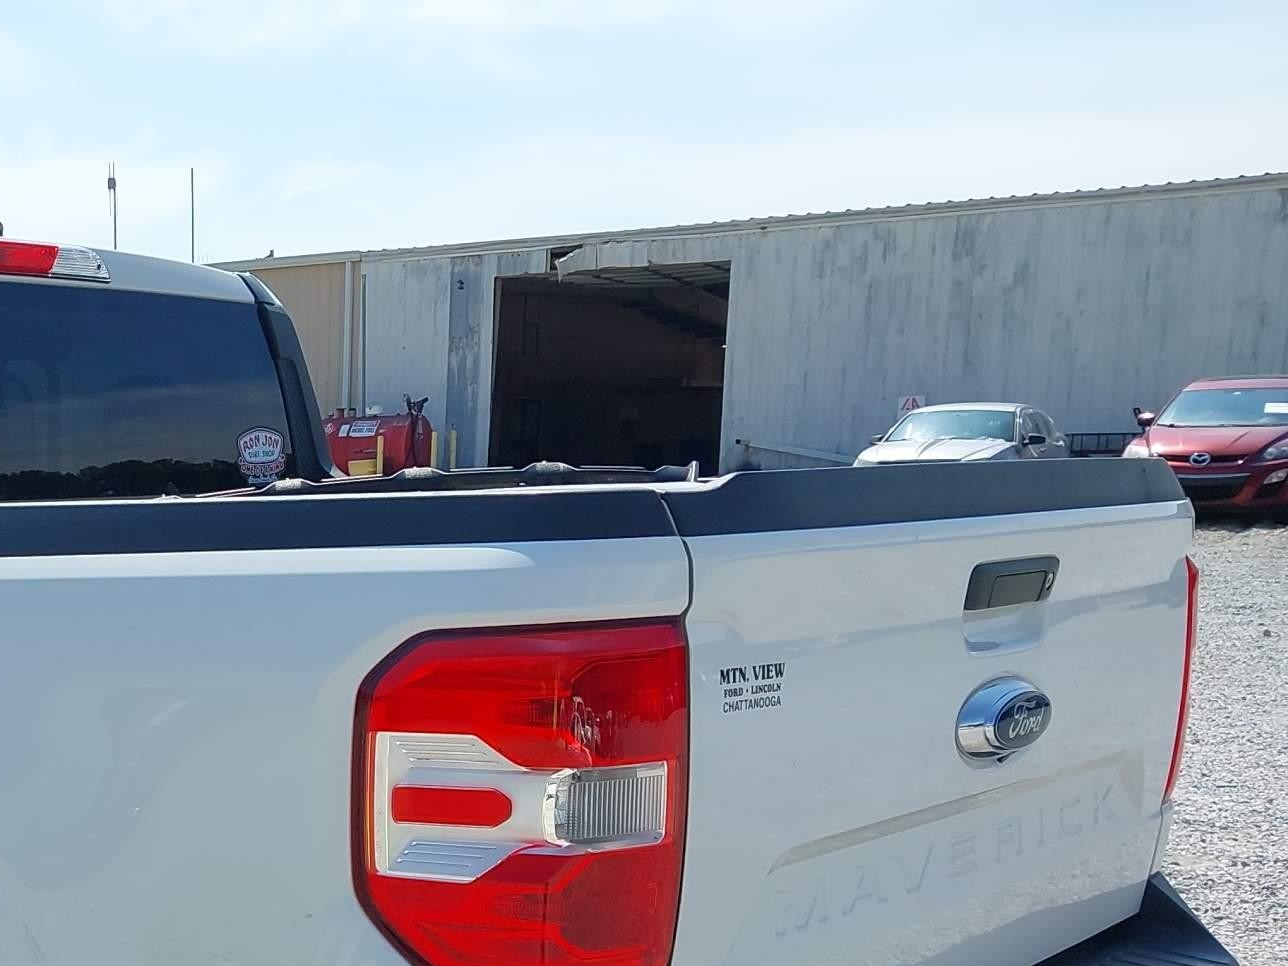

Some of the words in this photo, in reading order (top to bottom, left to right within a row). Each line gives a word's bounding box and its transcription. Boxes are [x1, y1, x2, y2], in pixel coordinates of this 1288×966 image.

[242, 434, 260, 453] RON
[261, 434, 280, 449] JON
[719, 666, 750, 686] MTN.
[752, 662, 786, 681] VIEW
[723, 687, 744, 698] FORD
[751, 682, 782, 695] LINCOLN
[722, 695, 782, 713] CHATTANOOGA
[1008, 699, 1044, 740] Ford
[774, 782, 1118, 940] MAVERICK
